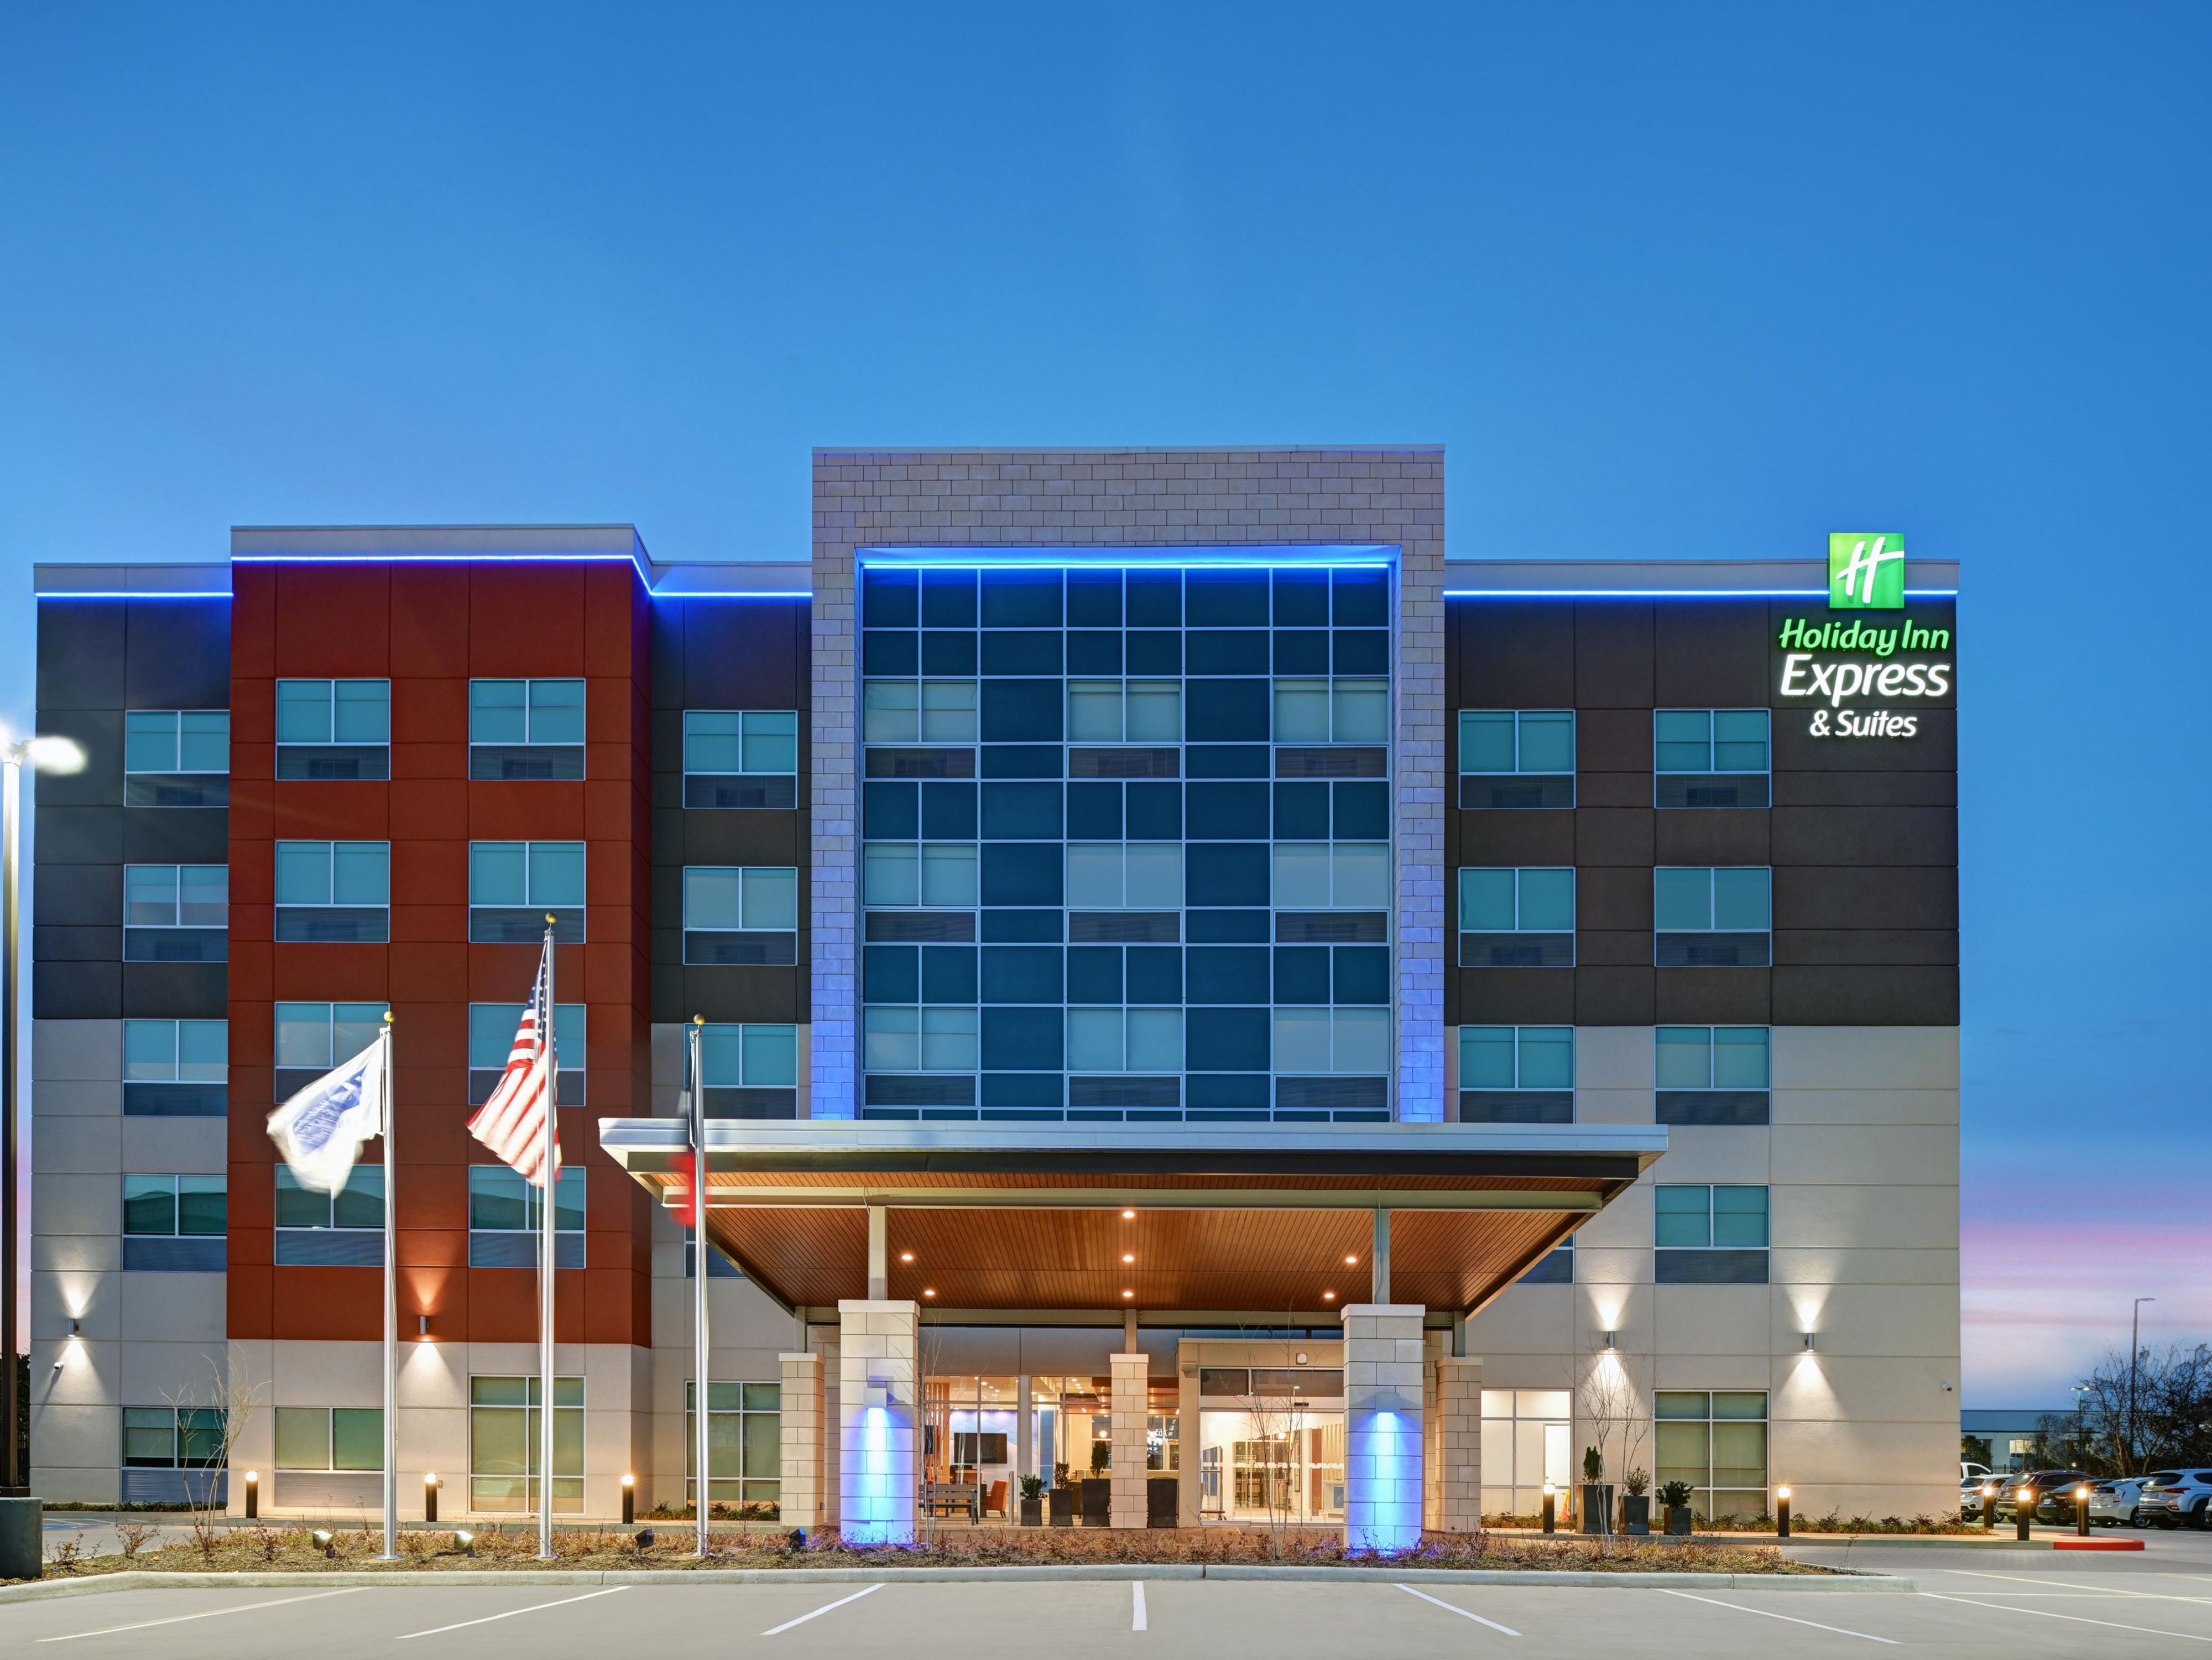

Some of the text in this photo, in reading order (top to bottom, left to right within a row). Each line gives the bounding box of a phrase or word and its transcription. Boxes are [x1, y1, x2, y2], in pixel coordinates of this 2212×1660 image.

[1837, 537, 1904, 603] H
[1778, 618, 1949, 656] Holiday Inn
[1780, 653, 1950, 707] Express
[1809, 710, 1918, 737] & Suites
